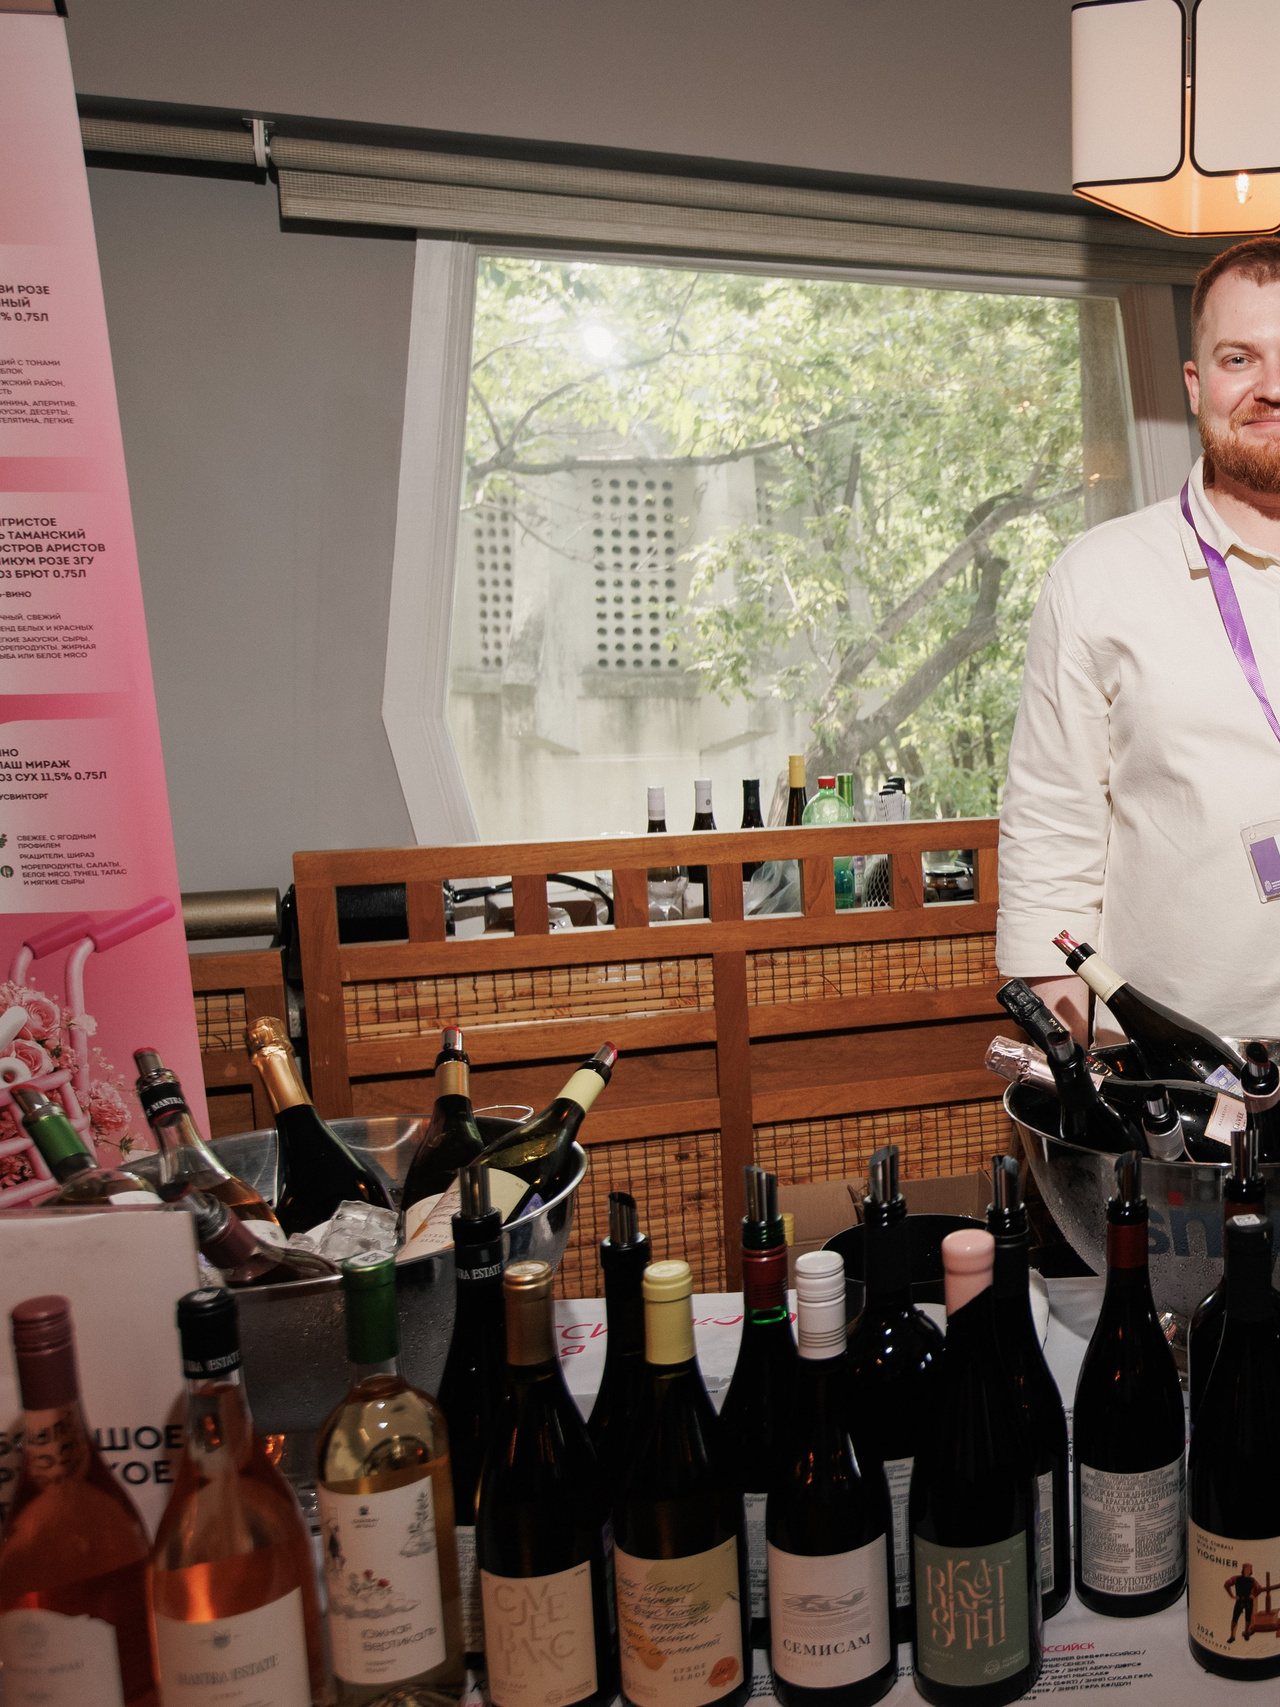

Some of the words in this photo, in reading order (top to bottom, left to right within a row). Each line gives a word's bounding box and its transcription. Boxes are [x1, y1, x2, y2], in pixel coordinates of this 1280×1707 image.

[18, 285, 51, 295] РОЗЕ
[0, 297, 31, 308] НЫЙ
[15, 312, 49, 322] 0,75Л
[26, 359, 61, 367] ТОНАМИ
[0, 518, 57, 527] ГРИСТОЕ
[8, 529, 86, 540] ТАМАНСКИЙ
[0, 544, 43, 552] СТРОВ
[46, 543, 106, 552] АРИСТОВ
[0, 557, 35, 566] ИКУМ
[39, 556, 70, 565] РОЗЕ
[73, 556, 94, 565] ЗГУ
[15, 570, 49, 578] БРЮТ
[53, 570, 87, 579] 0,75Л
[0, 748, 19, 757] НО
[25, 760, 71, 769] МИРАЖ
[15, 773, 39, 781] СУХ
[41, 772, 72, 781] 11,5%
[74, 771, 107, 780] 0,75Л
[57, 833, 97, 841] ЯГОДНЫМ
[472, 1263, 502, 1280] ESTATE
[208, 1350, 242, 1371] ESTATE
[1196, 1546, 1239, 1569] VIOGNIER
[361, 1622, 414, 1639] Южная
[1196, 1622, 1215, 1639] 2024
[783, 1633, 872, 1657] СЕМИСАМ
[231, 1654, 281, 1683] ESTATE
